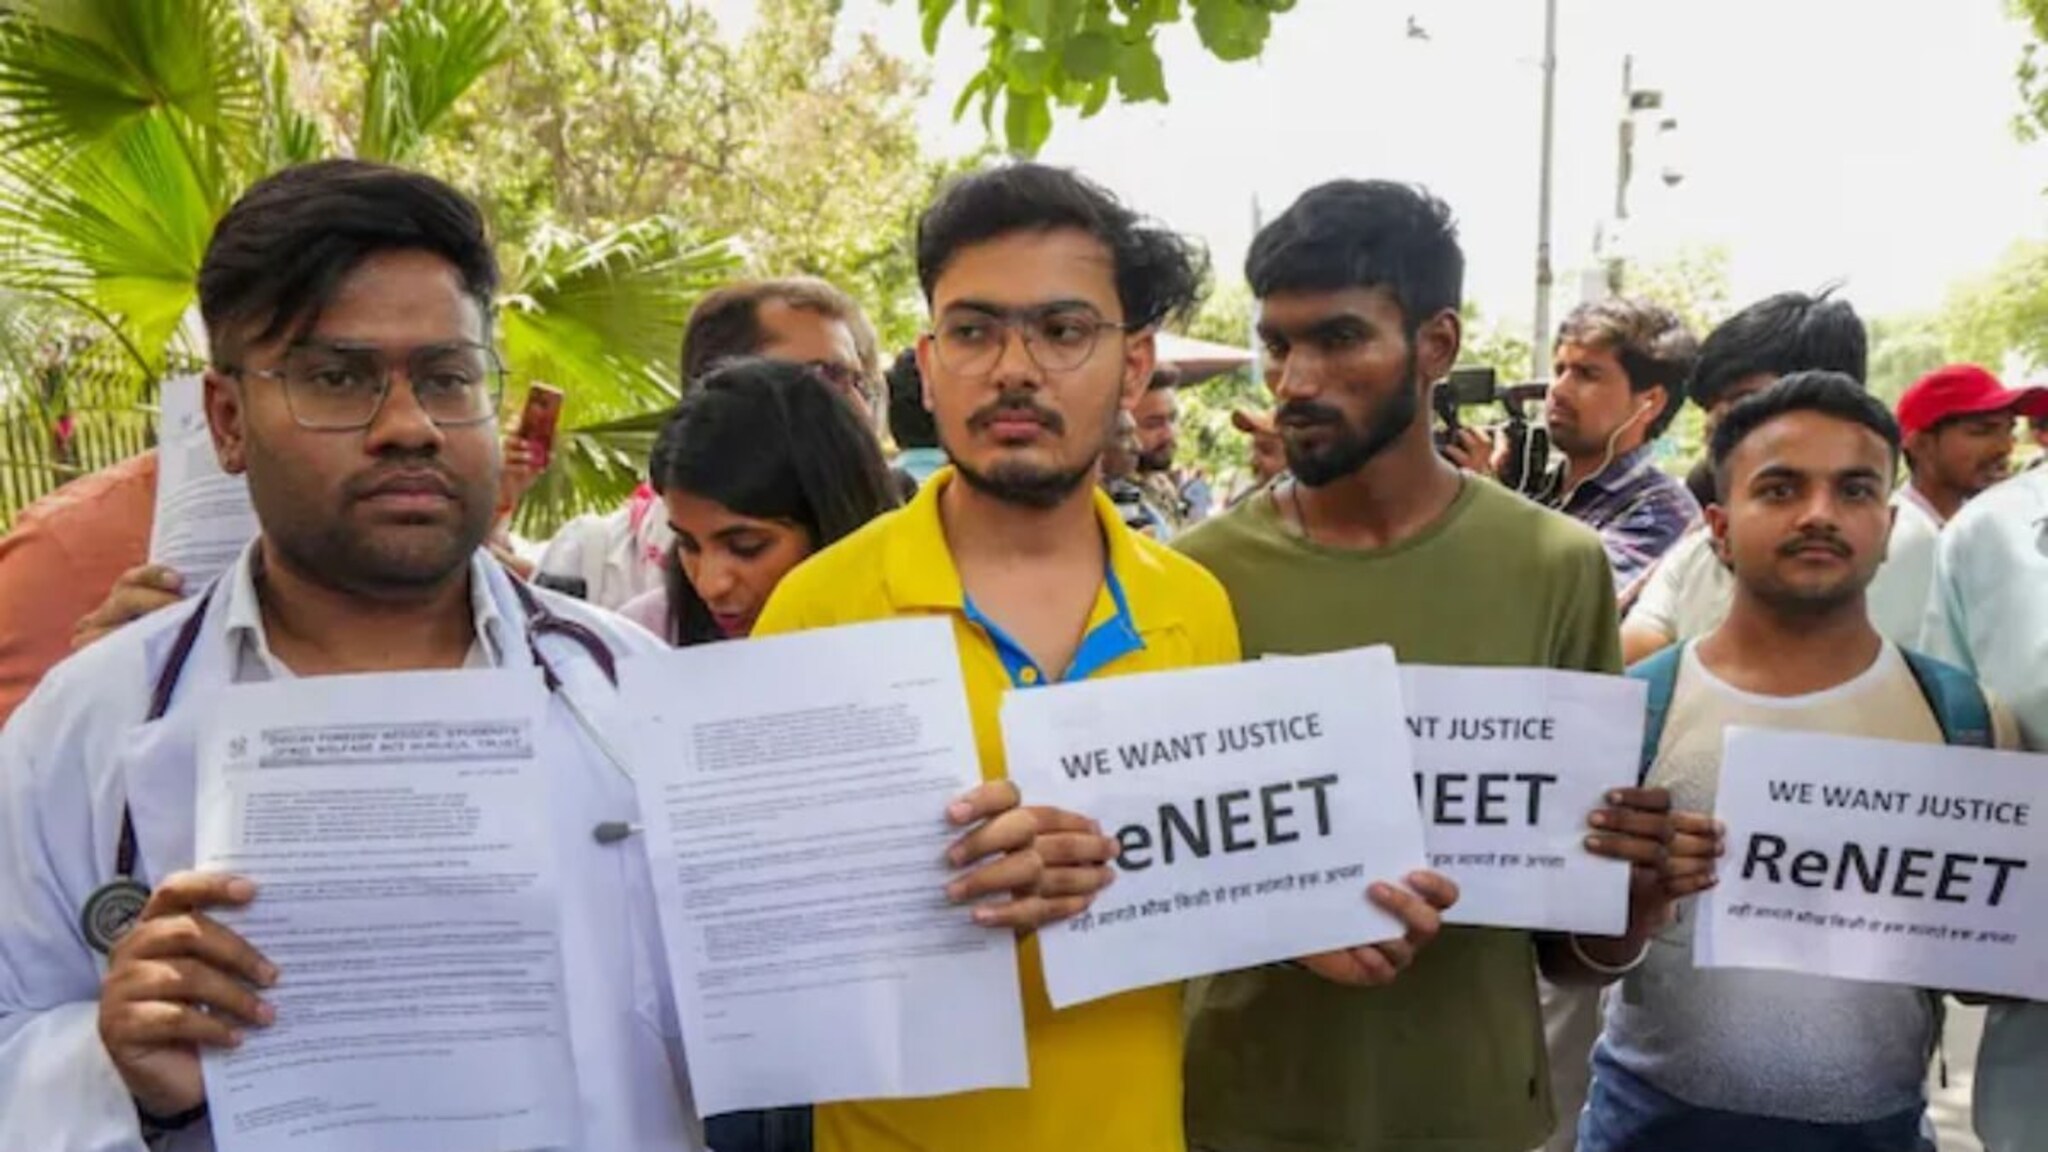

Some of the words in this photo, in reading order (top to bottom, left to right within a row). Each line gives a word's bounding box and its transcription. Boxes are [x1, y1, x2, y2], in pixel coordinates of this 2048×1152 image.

[1061, 749, 1110, 779] WE
[1119, 732, 1208, 769] WANT
[1216, 713, 1322, 752] JUSTICE
[1406, 716, 1440, 739] NT
[1448, 717, 1555, 740] JUSTICE
[1114, 774, 1338, 871] eNEET
[1414, 772, 1557, 826] EET
[1768, 780, 1814, 804] WE
[1822, 785, 1911, 813] WANT
[1917, 796, 2031, 827] JUSTICE
[1741, 833, 2028, 907] ReNEET
